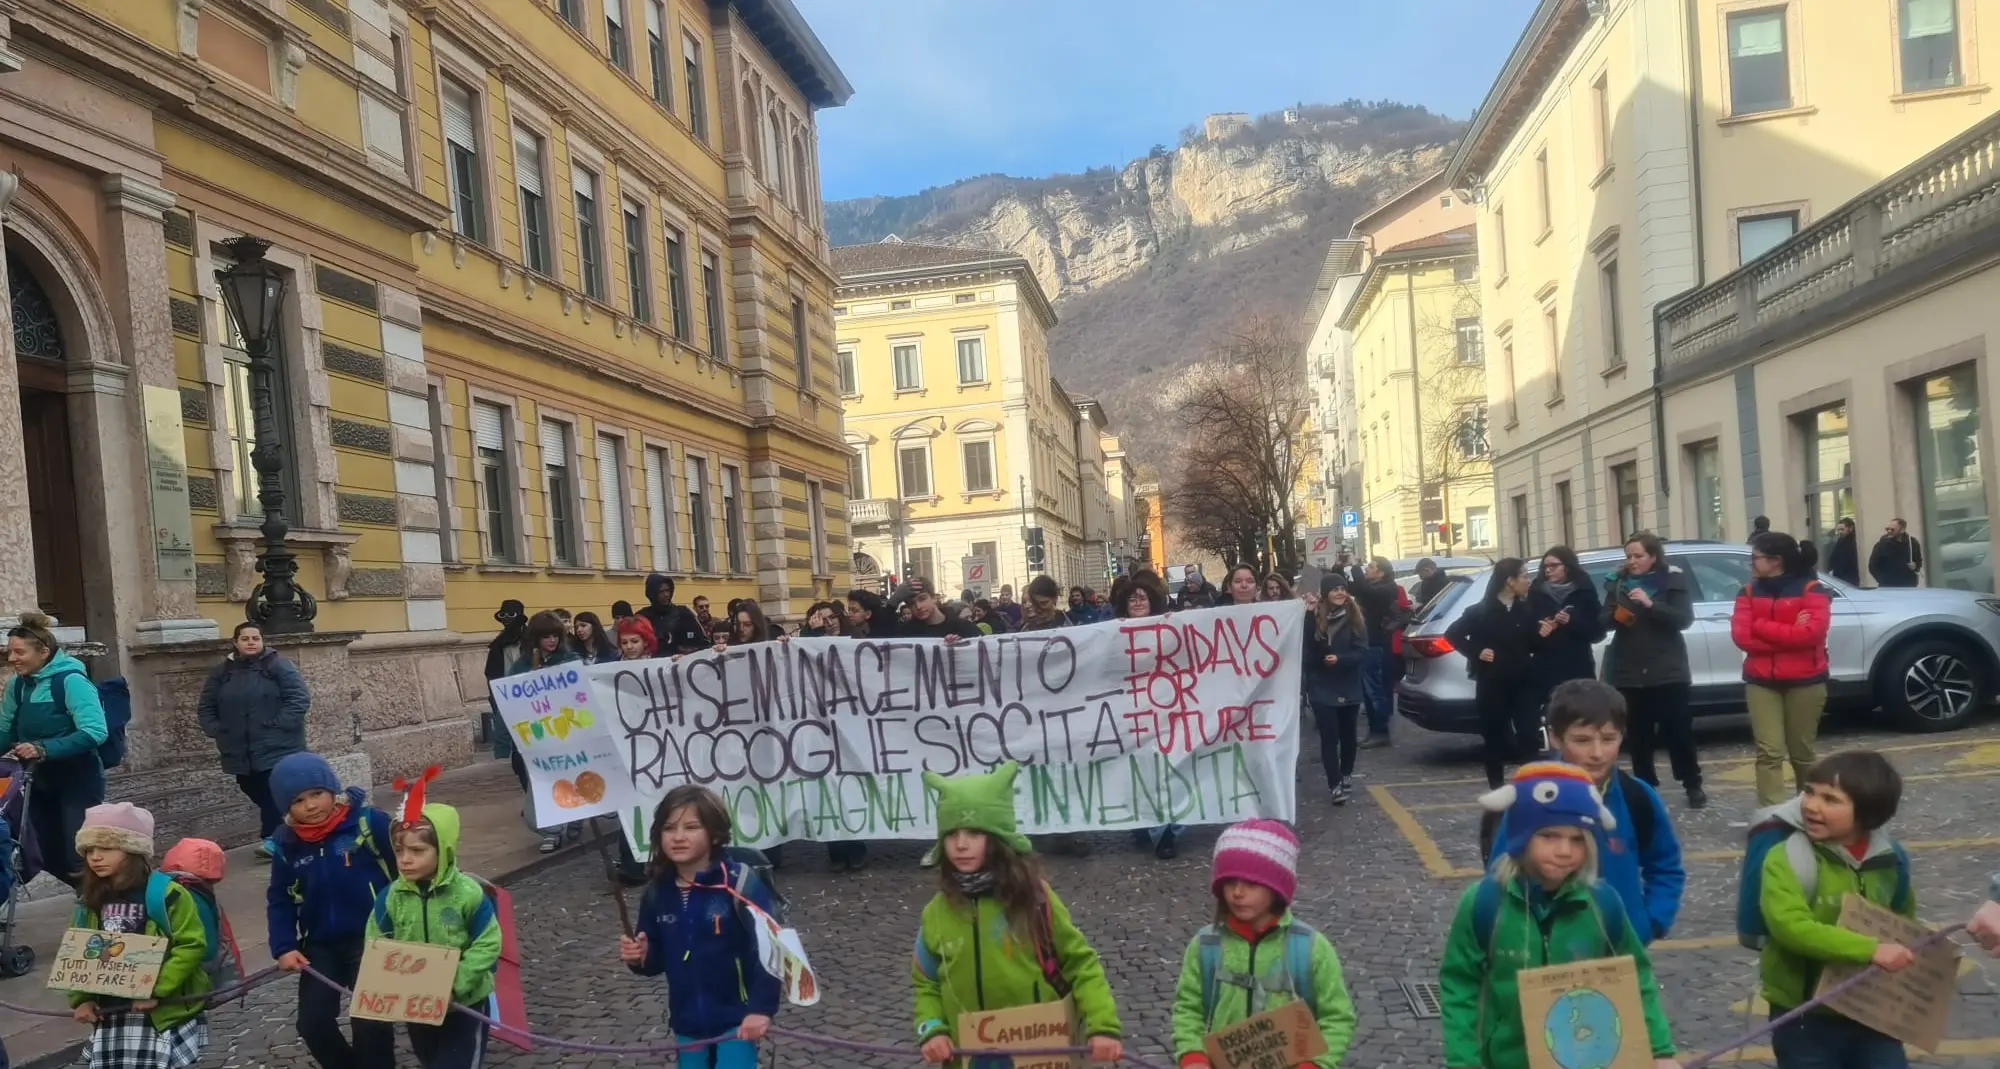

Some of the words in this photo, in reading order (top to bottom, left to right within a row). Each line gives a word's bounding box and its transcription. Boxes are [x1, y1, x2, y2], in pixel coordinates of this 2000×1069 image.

[1345, 514, 1354, 525] P
[1119, 615, 1280, 678] FRIDAYS
[496, 670, 579, 701] VOGLIAMO
[614, 664, 685, 732] CHI
[686, 641, 858, 732] SEMINA
[854, 635, 1077, 717] CEMENTO
[1124, 669, 1199, 710] FOR
[531, 695, 551, 714] UN
[512, 706, 595, 748] FUTURO
[1123, 699, 1276, 754] FUTURE
[624, 717, 912, 790] RACCOGLIE
[1074, 742, 1262, 826] VENDITA
[60, 958, 89, 971] TUTTI
[96, 959, 140, 973] INSIEME
[383, 949, 427, 975] ECO
[358, 990, 399, 1014] NOT
[405, 994, 445, 1019] EGO
